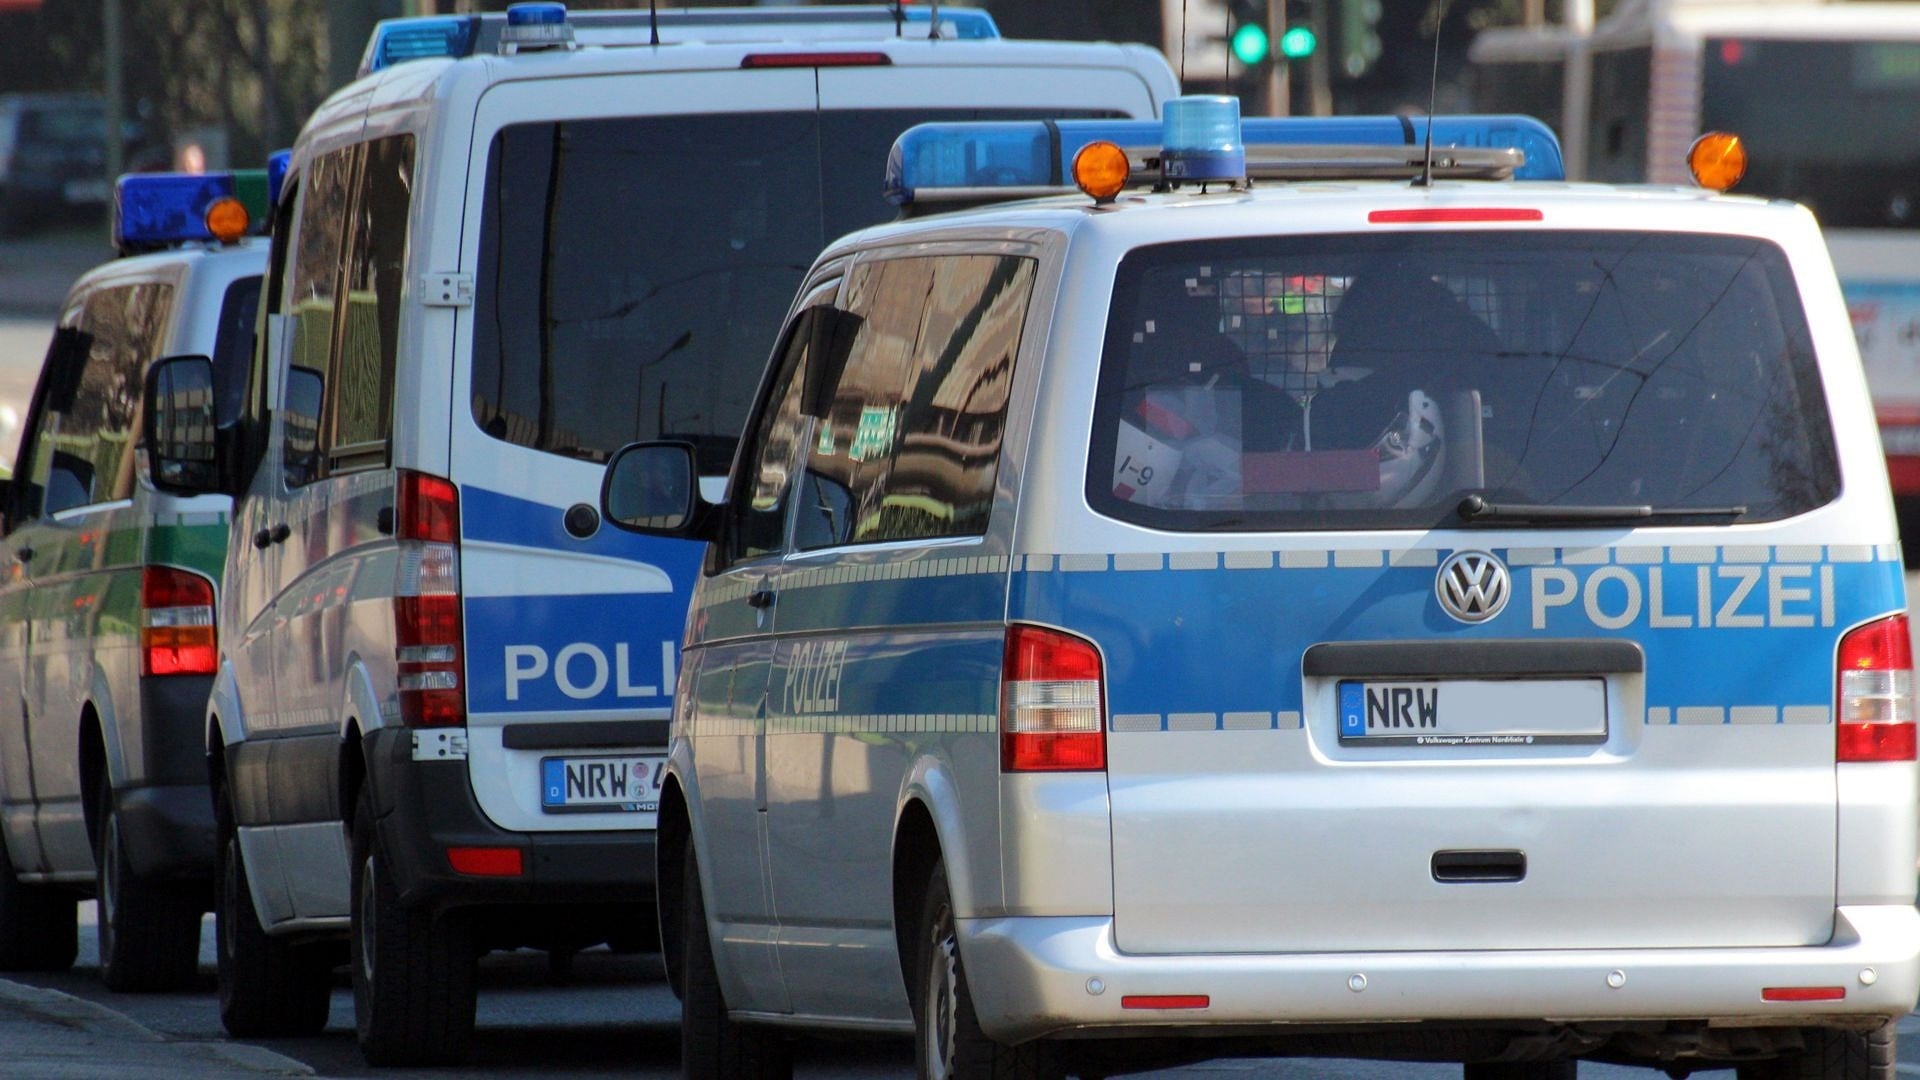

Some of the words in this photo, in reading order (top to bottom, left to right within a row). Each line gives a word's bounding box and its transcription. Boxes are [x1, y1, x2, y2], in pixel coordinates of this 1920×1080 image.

[1438, 552, 1509, 621] VW
[1531, 564, 1836, 630] POLIZEI
[783, 641, 848, 714] POLIZEI
[1348, 714, 1358, 727] D
[1366, 687, 1438, 729] NRW
[1425, 736, 1463, 744] Volkswagen
[566, 763, 627, 799] NRW
